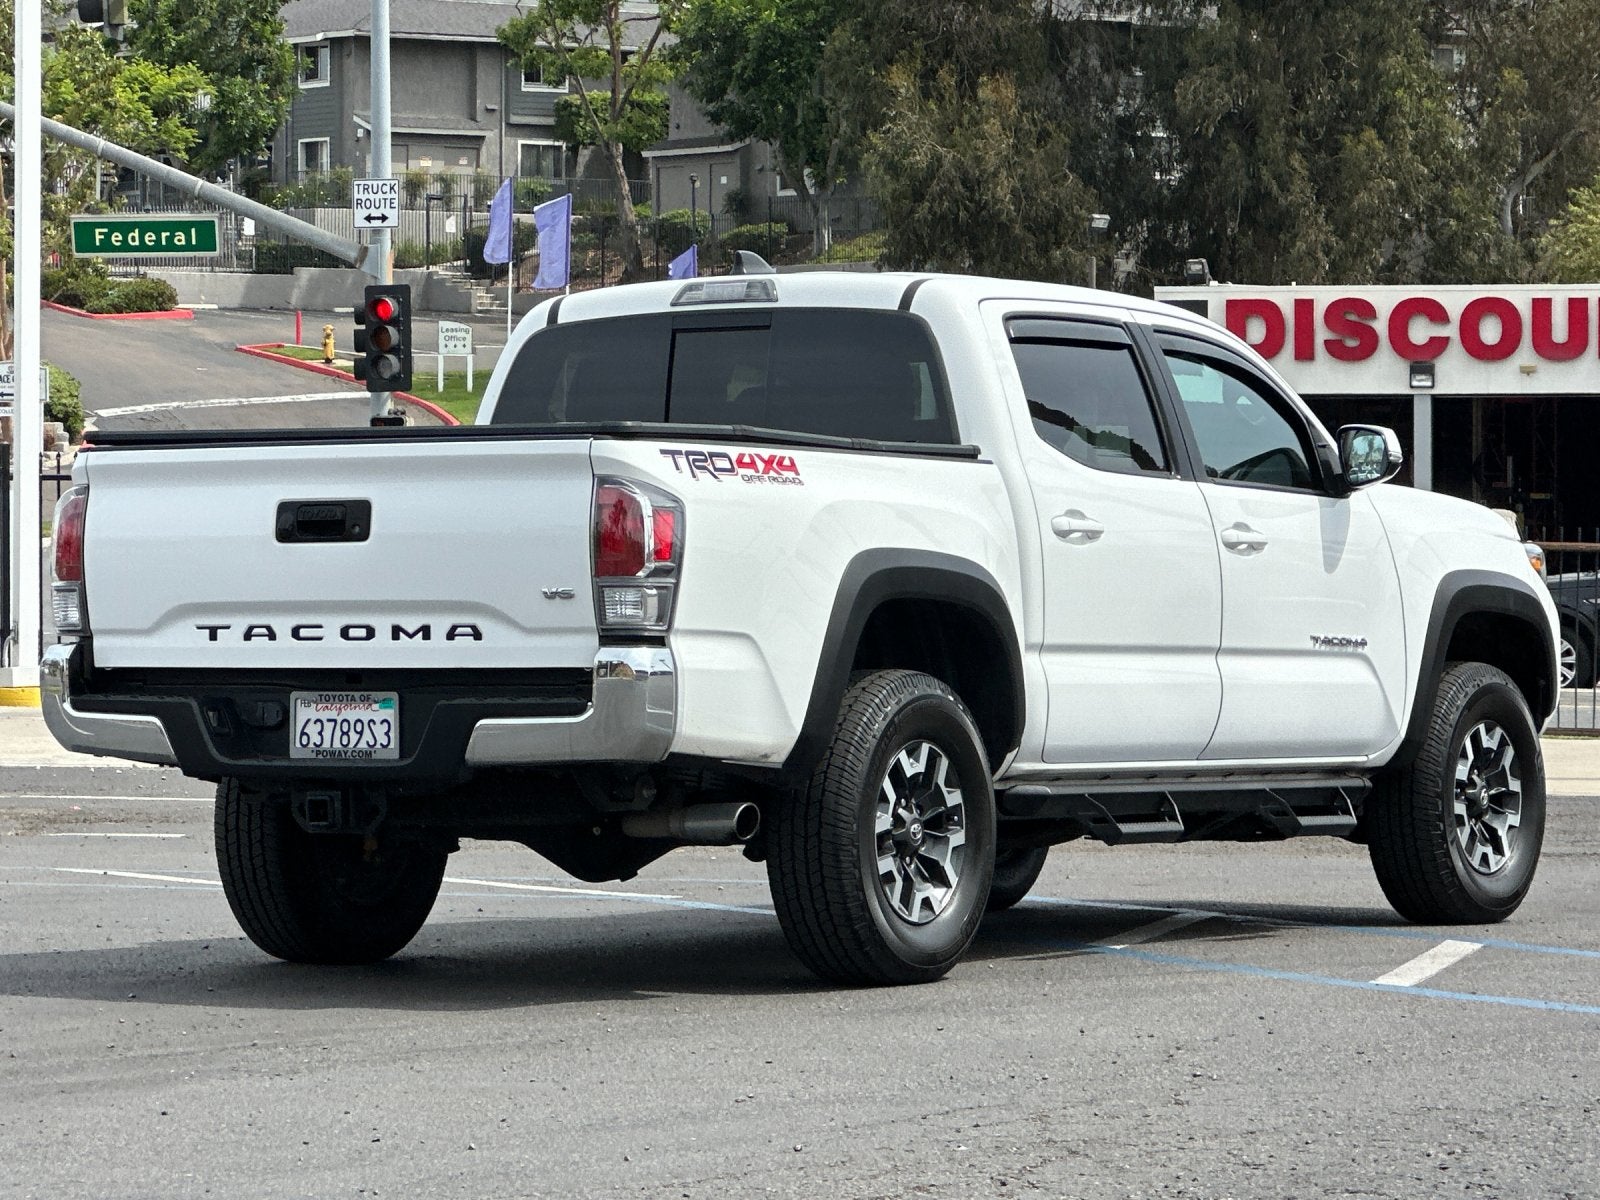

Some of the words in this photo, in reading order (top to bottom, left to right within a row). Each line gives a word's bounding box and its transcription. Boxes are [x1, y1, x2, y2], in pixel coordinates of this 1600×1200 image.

[355, 183, 397, 195] TRUCK
[355, 197, 397, 210] ROUTE
[94, 228, 197, 246] Federal
[440, 326, 470, 335] Leasing
[1225, 296, 1600, 362] DISCOU
[443, 334, 467, 342] Office
[659, 448, 738, 482] TRD
[740, 474, 767, 484] OFF
[767, 475, 804, 486] ROAD
[542, 587, 575, 600] V6
[195, 623, 484, 642] TACOMA
[1310, 634, 1368, 648] TACOMA
[318, 694, 356, 703] TOYOTA
[359, 694, 373, 703] OF
[315, 702, 379, 716] California
[299, 718, 391, 748] 63789S3
